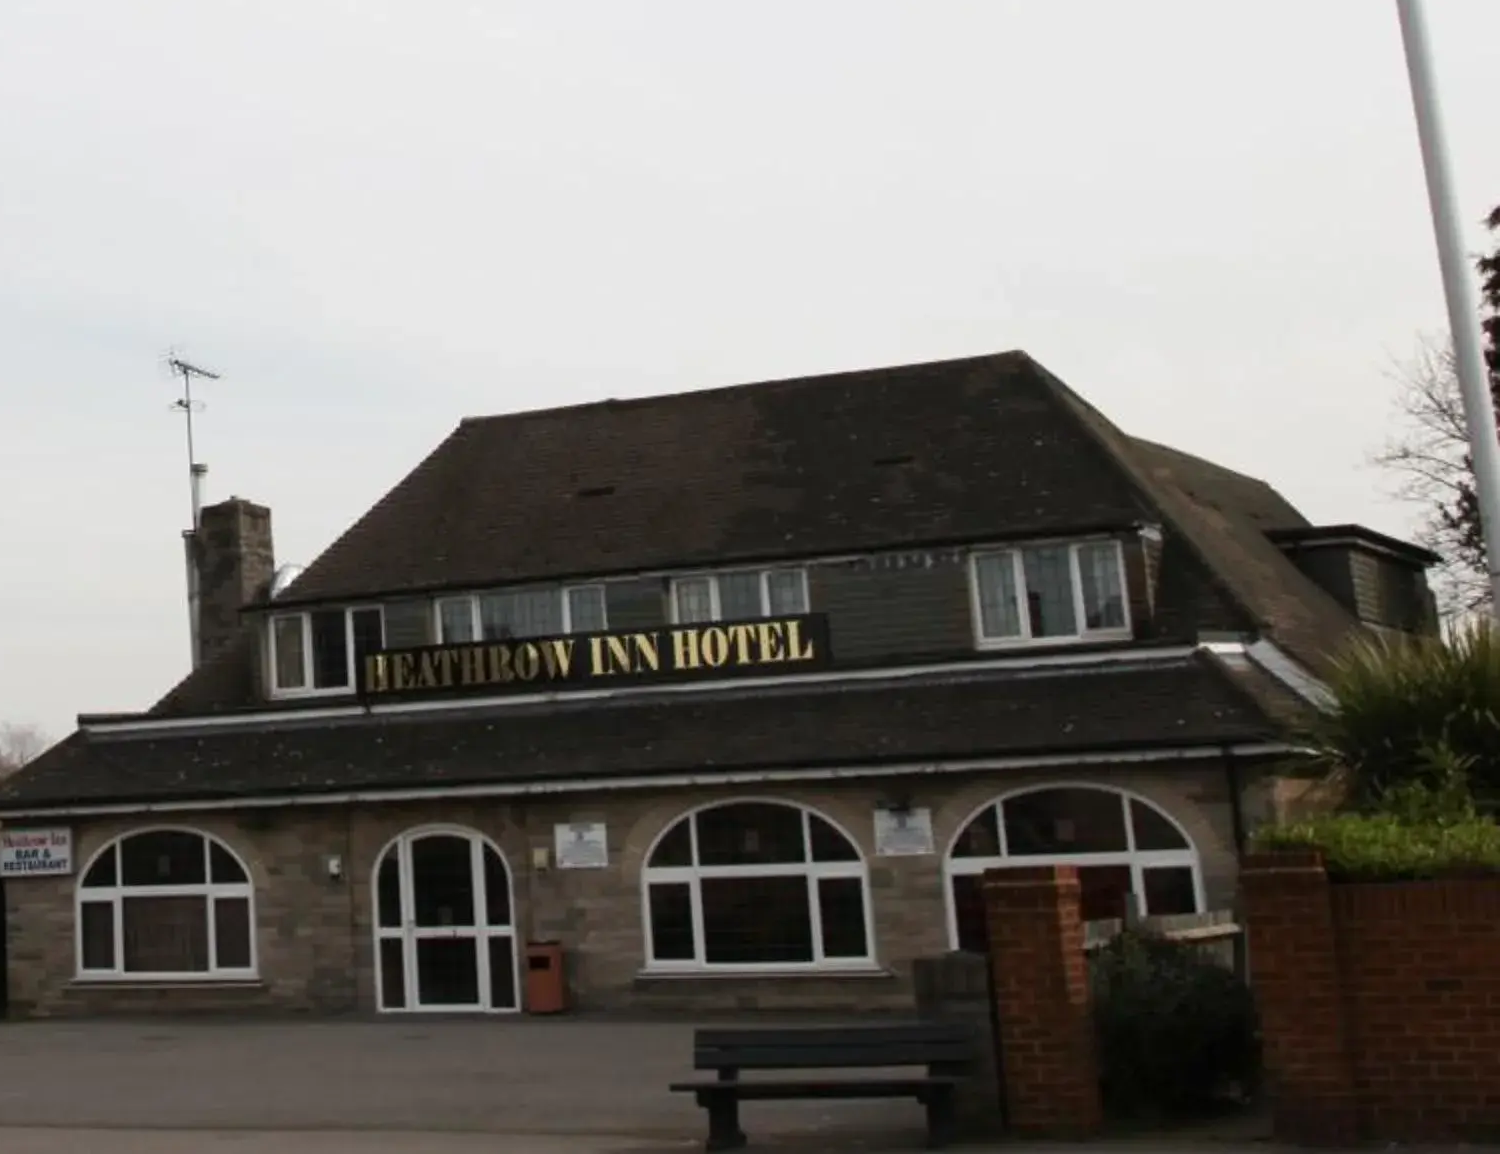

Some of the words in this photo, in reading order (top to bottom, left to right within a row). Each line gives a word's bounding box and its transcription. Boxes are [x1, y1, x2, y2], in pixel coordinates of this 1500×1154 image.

[364, 638, 575, 693] HEATHROW
[589, 631, 660, 677] INN
[672, 620, 815, 670] HOTEL
[15, 849, 39, 859] BAR
[3, 858, 68, 871] RESTAURANT
